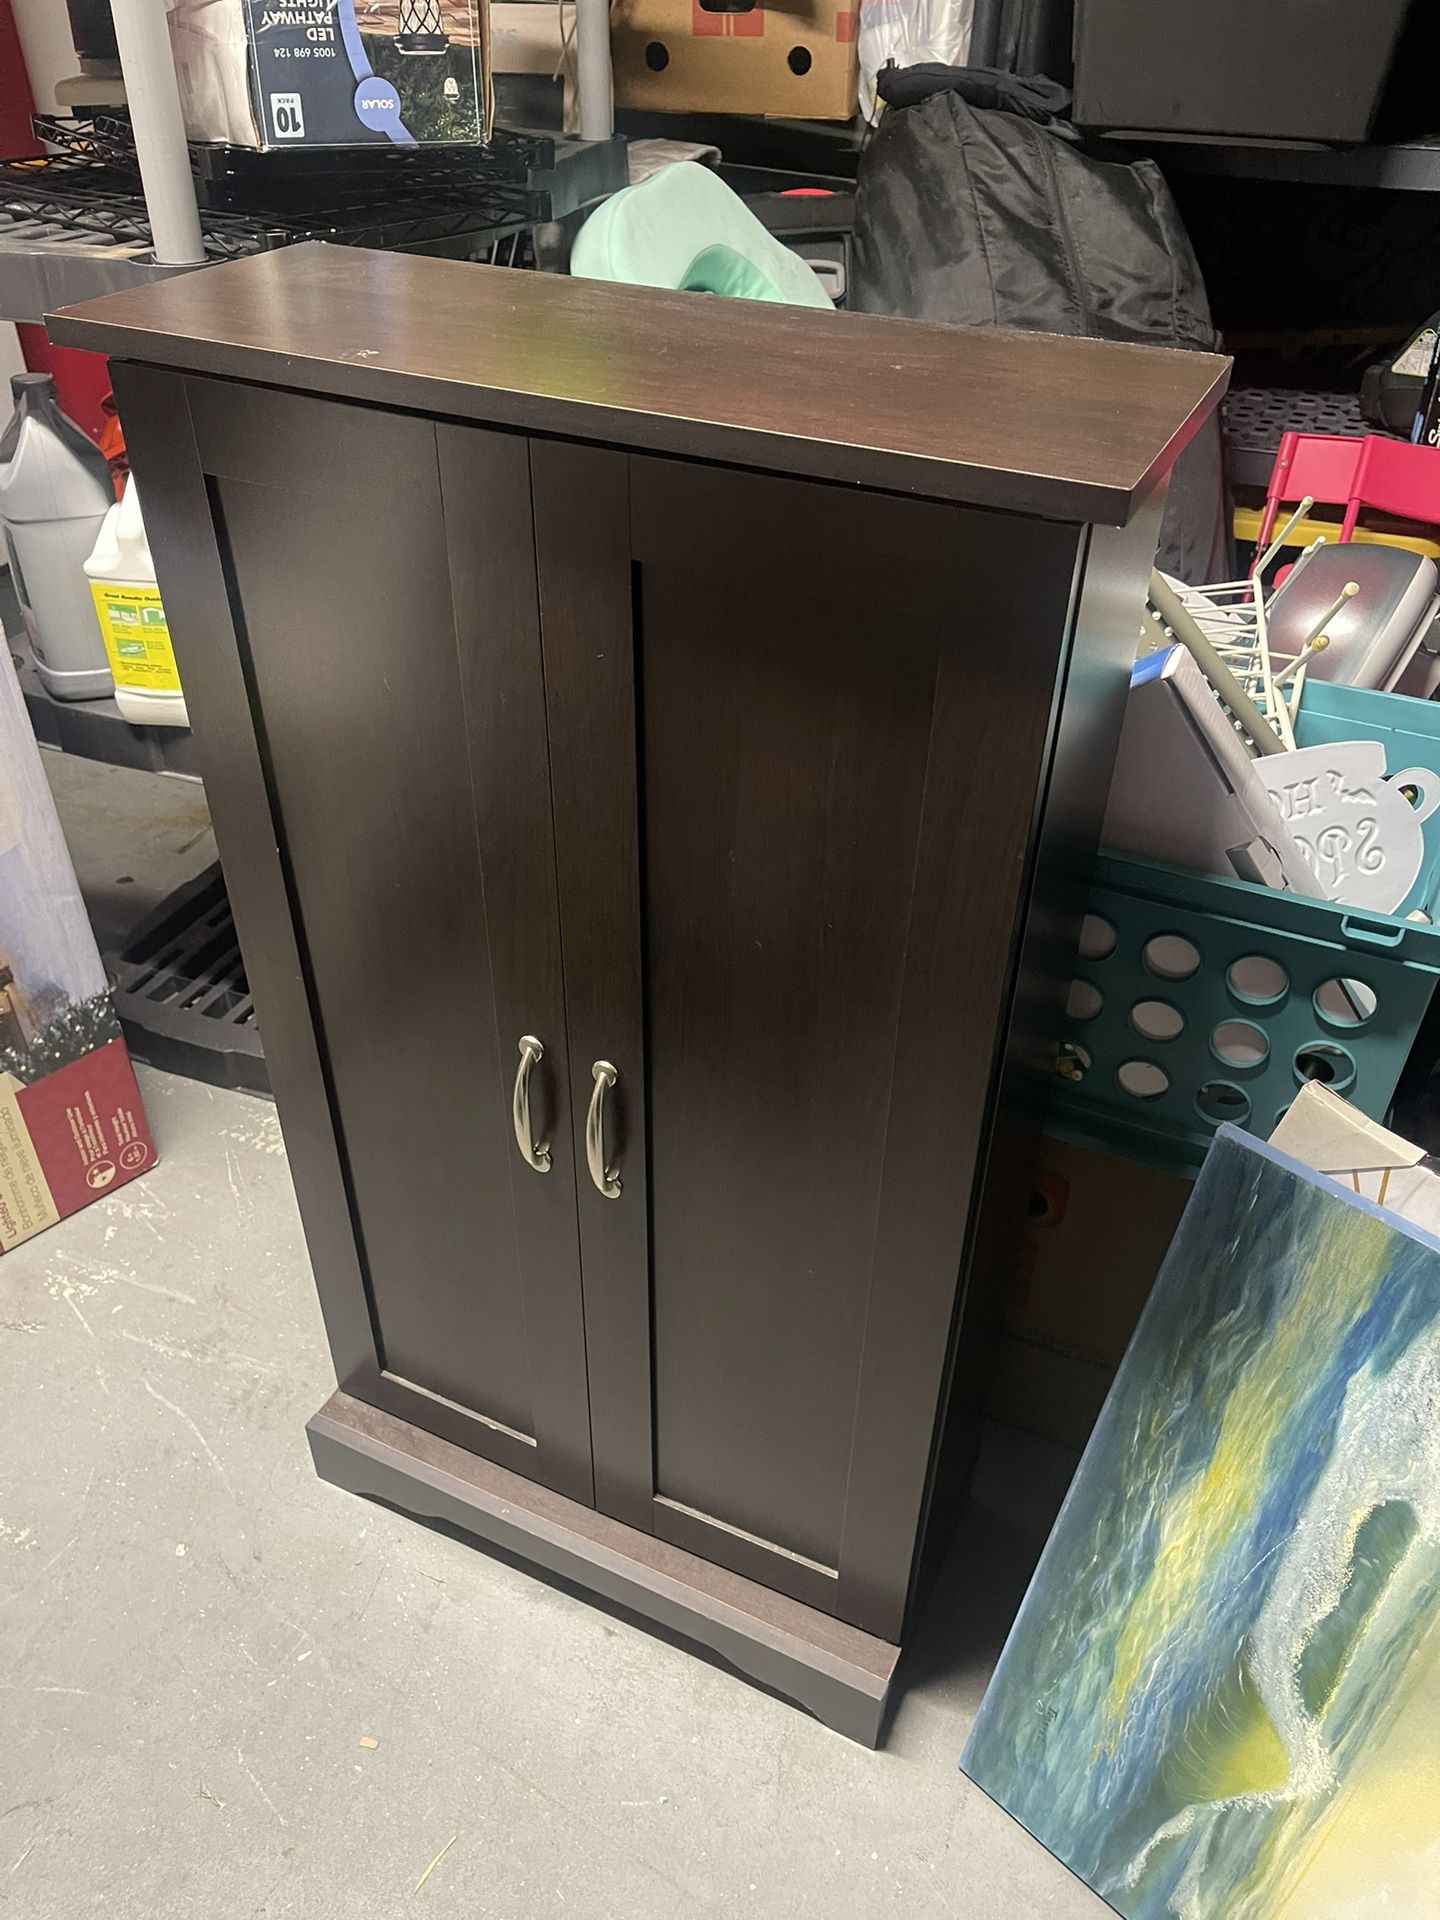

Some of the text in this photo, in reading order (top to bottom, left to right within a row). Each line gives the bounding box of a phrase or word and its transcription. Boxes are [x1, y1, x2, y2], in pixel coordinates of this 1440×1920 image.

[261, 11, 333, 25] PATHWAY
[306, 27, 335, 41] LED
[273, 48, 336, 58] 1005 698 124
[361, 99, 394, 110] SOLAR
[276, 106, 302, 133] 10
[25, 1172, 35, 1186] de
